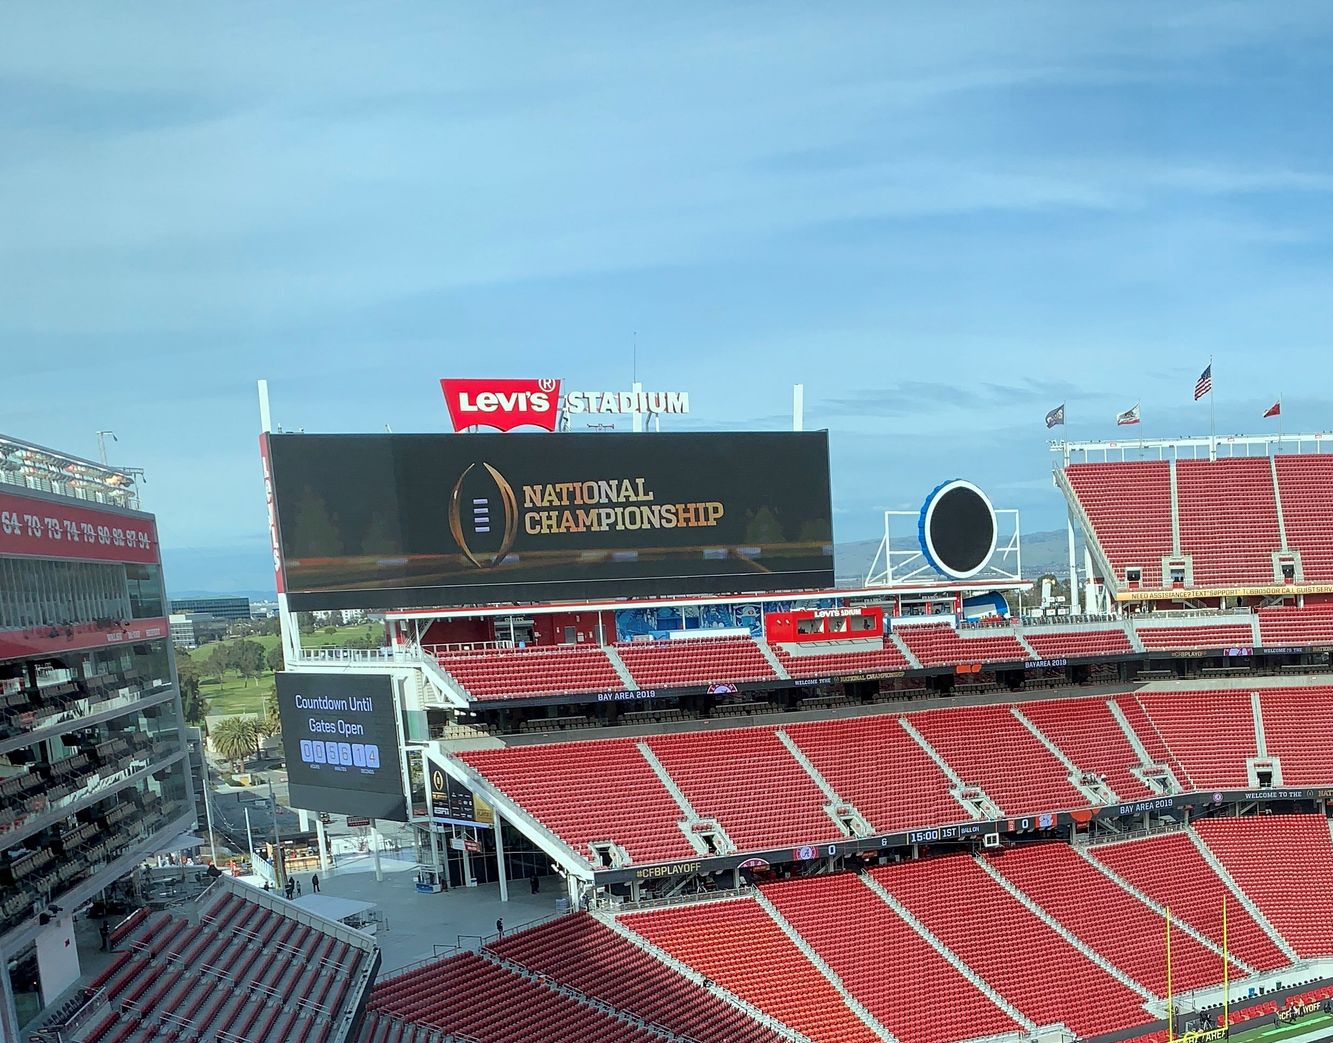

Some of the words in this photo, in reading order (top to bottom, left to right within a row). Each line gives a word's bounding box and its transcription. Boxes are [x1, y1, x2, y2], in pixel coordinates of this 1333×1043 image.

[567, 391, 690, 415] STADIUM
[523, 476, 654, 508] NATIONAL
[524, 501, 725, 535] CHAMPIONSHIP
[2, 512, 22, 535] 64
[24, 514, 44, 538] 70
[63, 519, 80, 542] 74
[1052, 658, 1067, 666] 2019
[295, 695, 348, 711] Countdown
[349, 697, 373, 711] Until
[598, 692, 611, 701] BAY
[612, 691, 635, 700] AREA
[636, 690, 656, 699] 2019
[309, 718, 336, 733] Gates
[338, 720, 364, 737] Open
[1245, 791, 1279, 799] WELCOME
[1288, 790, 1302, 798] THE
[1120, 805, 1134, 815] BAY
[1135, 802, 1154, 813] AREA
[1155, 799, 1174, 810] 2019
[911, 830, 938, 843] 15:00
[942, 827, 957, 838] 1ST
[636, 862, 702, 879] #CFBPLAYOFF
